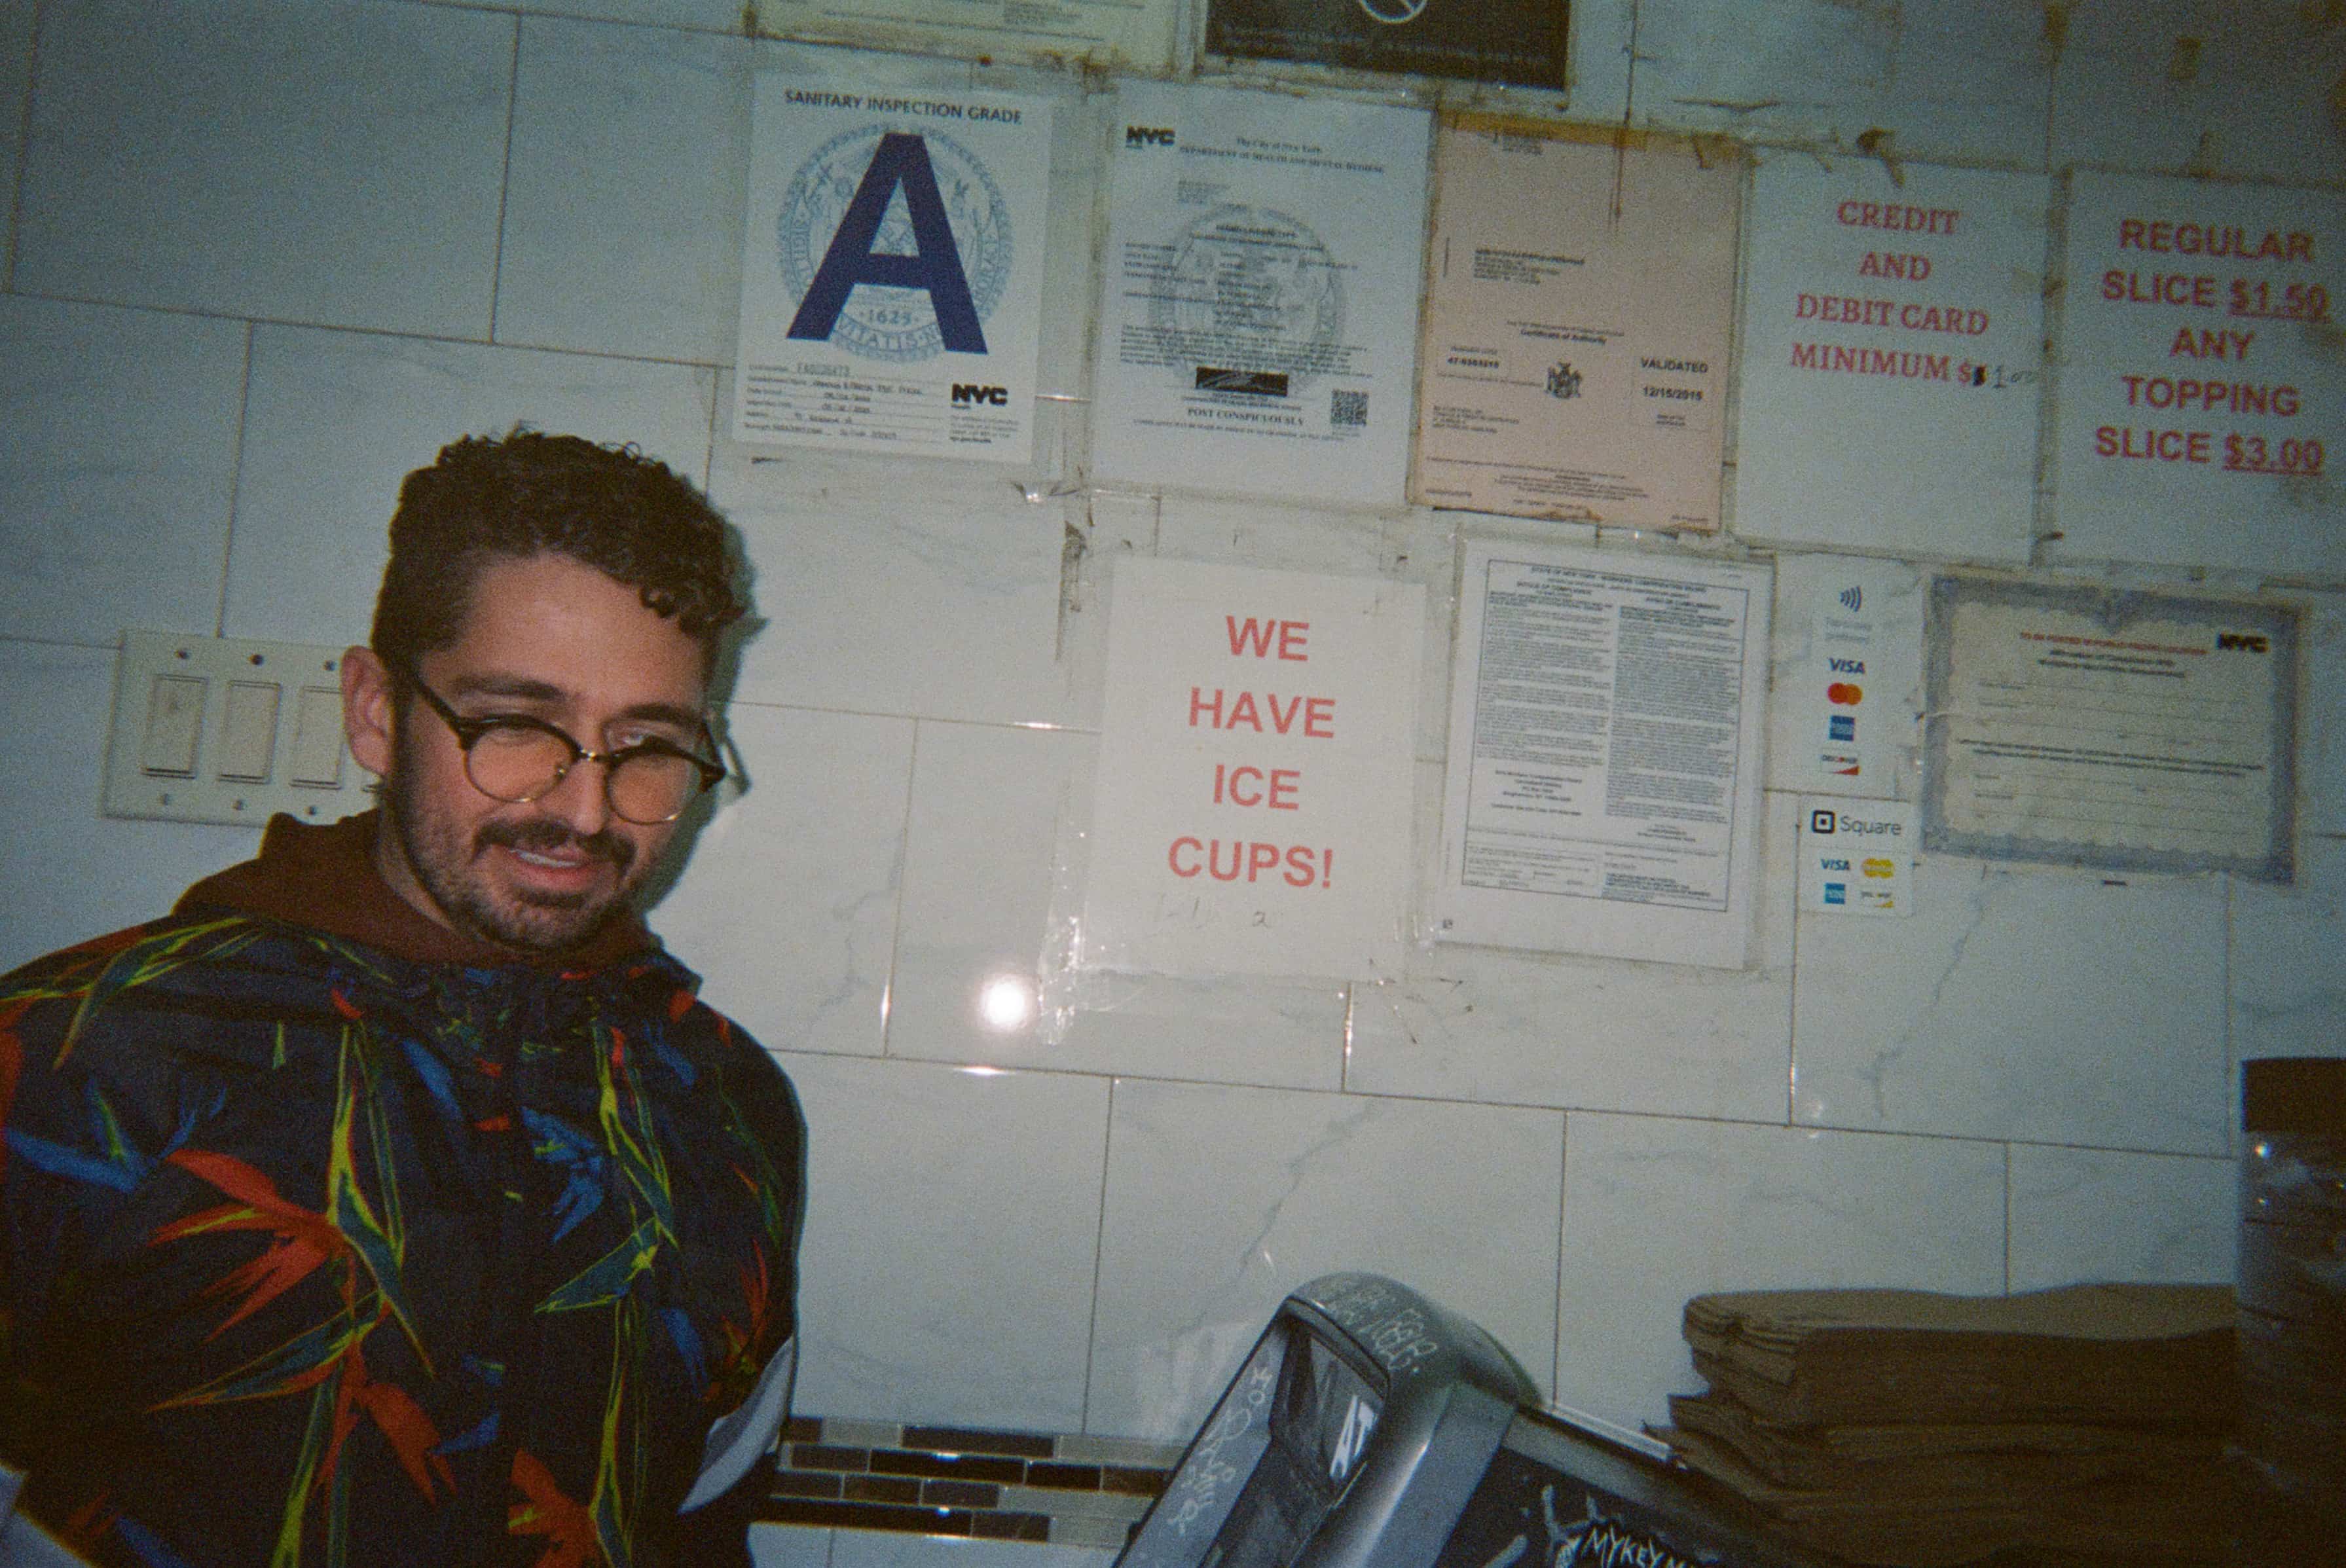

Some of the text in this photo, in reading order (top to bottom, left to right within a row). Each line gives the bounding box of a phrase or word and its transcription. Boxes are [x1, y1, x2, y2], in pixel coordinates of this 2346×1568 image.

[785, 89, 1023, 124] SANITARY INSPECTION GRADE
[1126, 125, 1176, 145] NYC
[1837, 200, 1961, 235] CREDIT
[786, 133, 989, 355] A
[2118, 217, 2315, 262] REGULAR
[1858, 251, 1933, 282] AND
[2102, 268, 2332, 323] SLICE $1.50
[1795, 293, 1990, 335] DEBIT CARD
[2169, 325, 2256, 360] ANY
[1641, 356, 1708, 373] VALIDATED
[1791, 342, 1951, 382] MINIMUM
[951, 383, 1008, 405] NYC
[2121, 374, 2301, 417] TOPPING
[1187, 407, 1215, 419] POST
[2095, 425, 2325, 476] SLICE $3.00
[1226, 615, 1310, 662] WE
[2216, 632, 2269, 654] NYC
[1829, 657, 1866, 675] VISA
[1188, 686, 1336, 738] HAVE
[1213, 764, 1300, 811] ICE
[1840, 815, 1903, 837] Square
[1168, 836, 1333, 889] CUPS!
[1820, 858, 1852, 871] VISA
